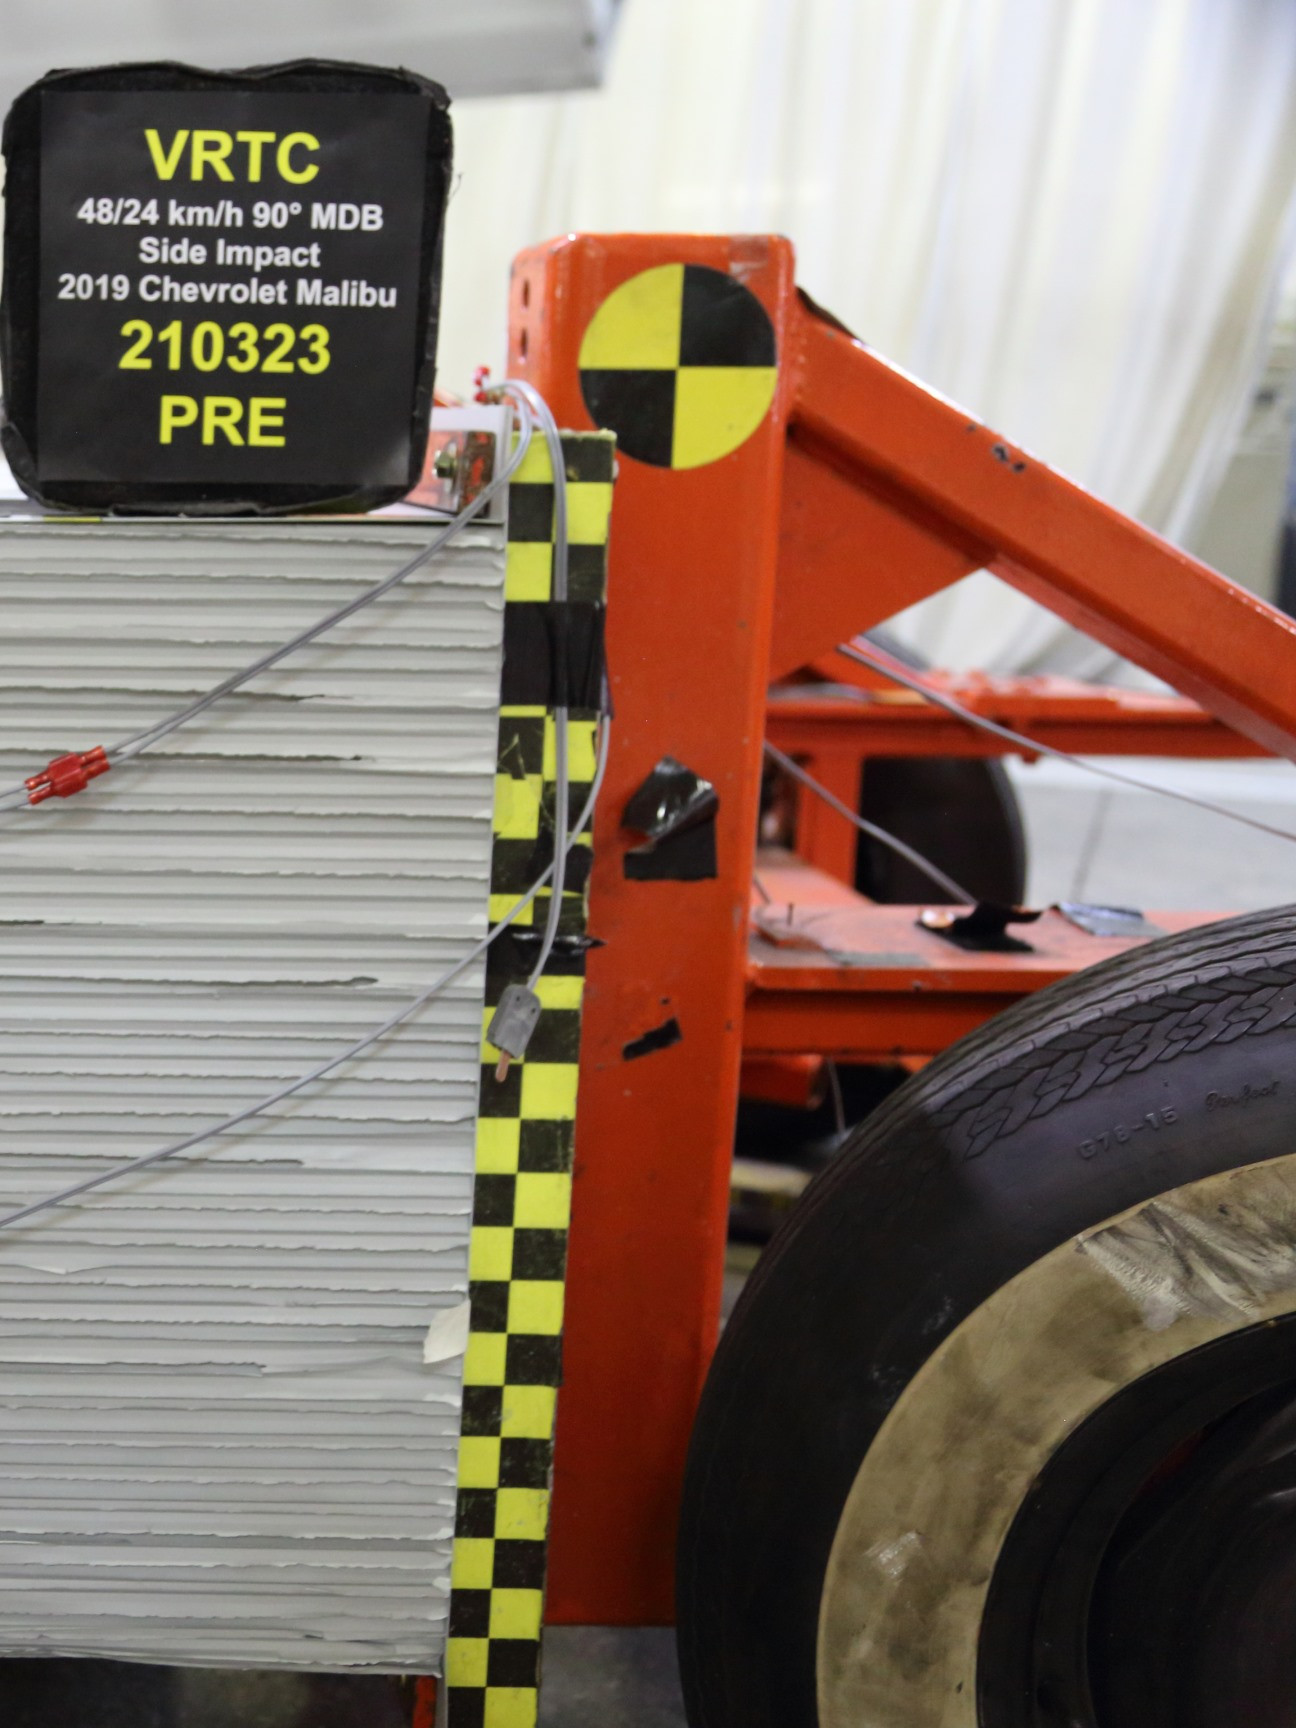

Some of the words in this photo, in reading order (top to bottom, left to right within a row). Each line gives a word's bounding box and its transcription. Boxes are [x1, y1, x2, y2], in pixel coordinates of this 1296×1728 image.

[144, 128, 320, 184] VRTC
[76, 197, 160, 226] 48/24
[168, 198, 244, 228] km/h
[252, 201, 302, 229] 90°
[310, 202, 384, 231] MDB
[139, 236, 208, 265] Side
[216, 238, 321, 272] Impact
[57, 273, 130, 301] 2019
[138, 275, 288, 305] Chevrolet
[296, 278, 397, 308] Malibu
[118, 319, 331, 375] 210323
[159, 395, 287, 447] PRE
[1078, 1105, 1179, 1159] G78-15
